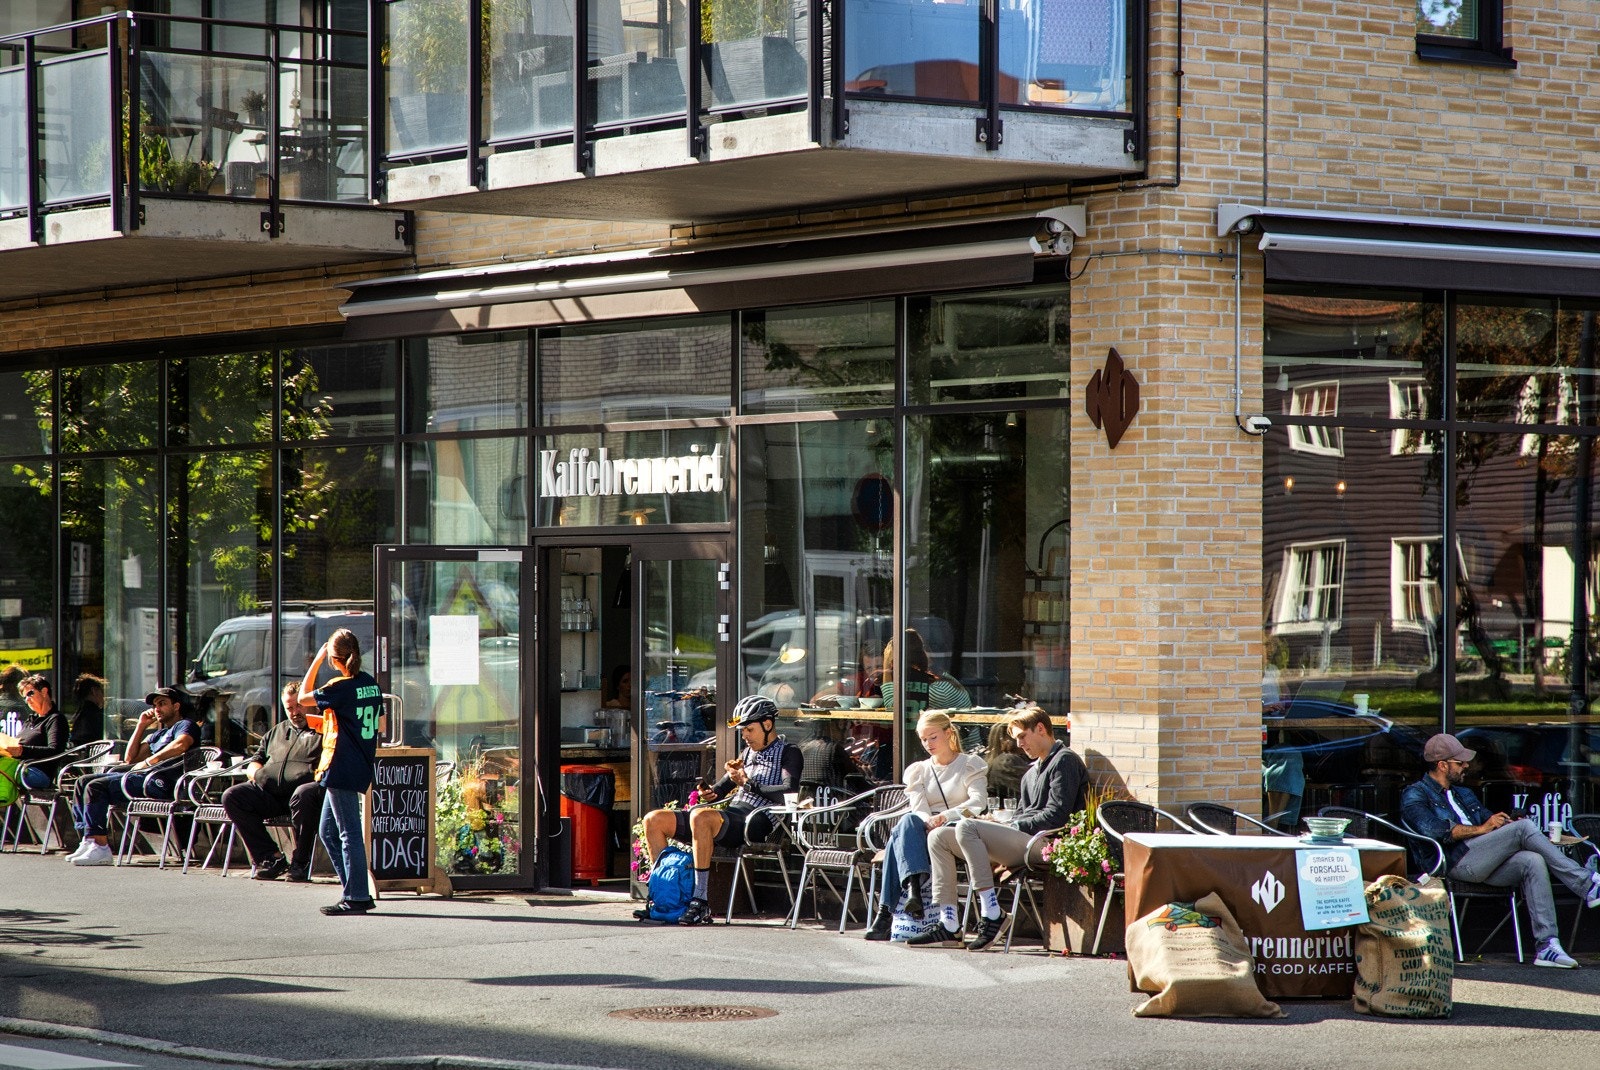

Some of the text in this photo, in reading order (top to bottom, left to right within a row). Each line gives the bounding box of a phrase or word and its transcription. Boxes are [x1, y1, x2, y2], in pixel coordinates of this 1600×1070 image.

[540, 443, 723, 498] Kaffebrenneriet
[0, 711, 23, 738] affe
[373, 759, 413, 786] VELKOMMEN
[372, 789, 428, 818] DEN STORE
[372, 837, 426, 876] I DAG!
[1310, 864, 1349, 874] FORSKJELL
[1240, 929, 1354, 960] renneriet
[1271, 963, 1305, 975] GOD
[1308, 962, 1355, 975] KAFFE
